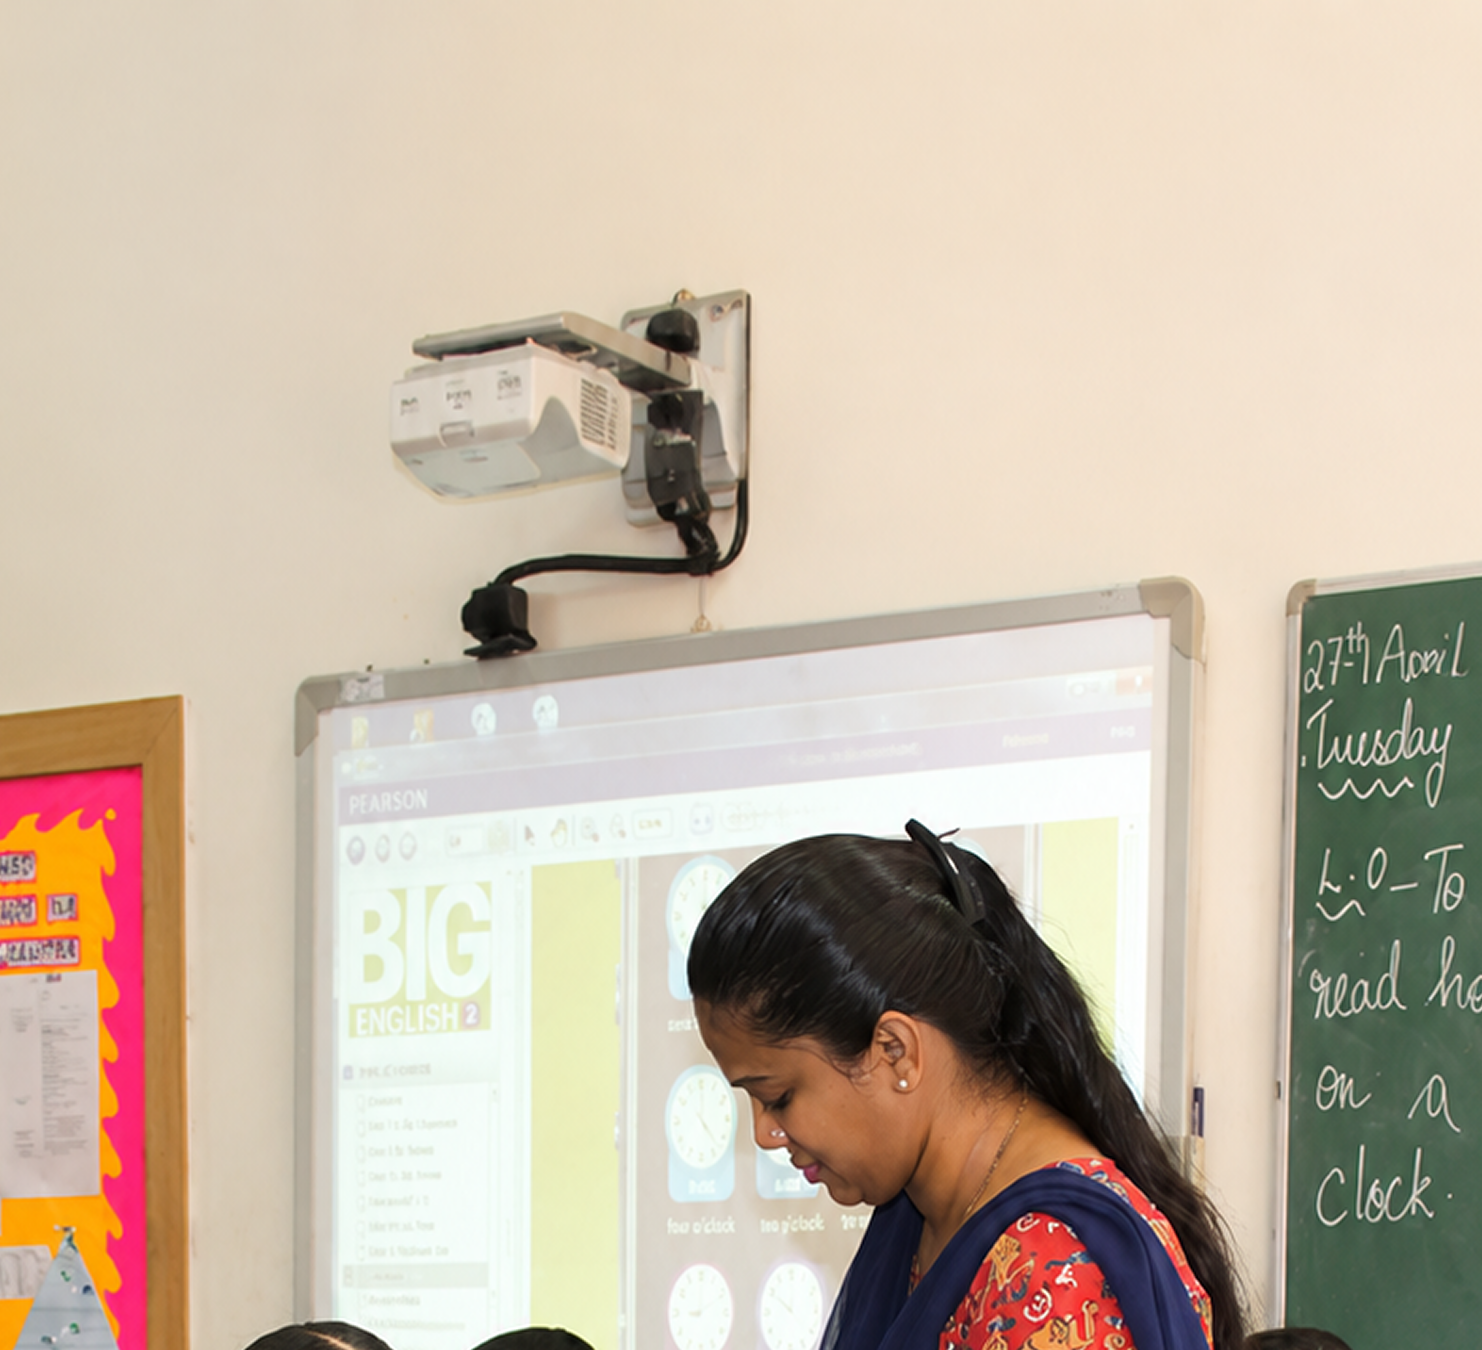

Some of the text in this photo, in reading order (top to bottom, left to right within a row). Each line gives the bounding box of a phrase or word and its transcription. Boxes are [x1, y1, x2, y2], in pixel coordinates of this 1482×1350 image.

[1306, 696, 1453, 809] Tuesday
[348, 788, 429, 815] PEARSON
[348, 882, 492, 1004] BIG
[1309, 939, 1408, 1020] read
[355, 1003, 459, 1036] ENGLISH
[1315, 1064, 1461, 1134] on a
